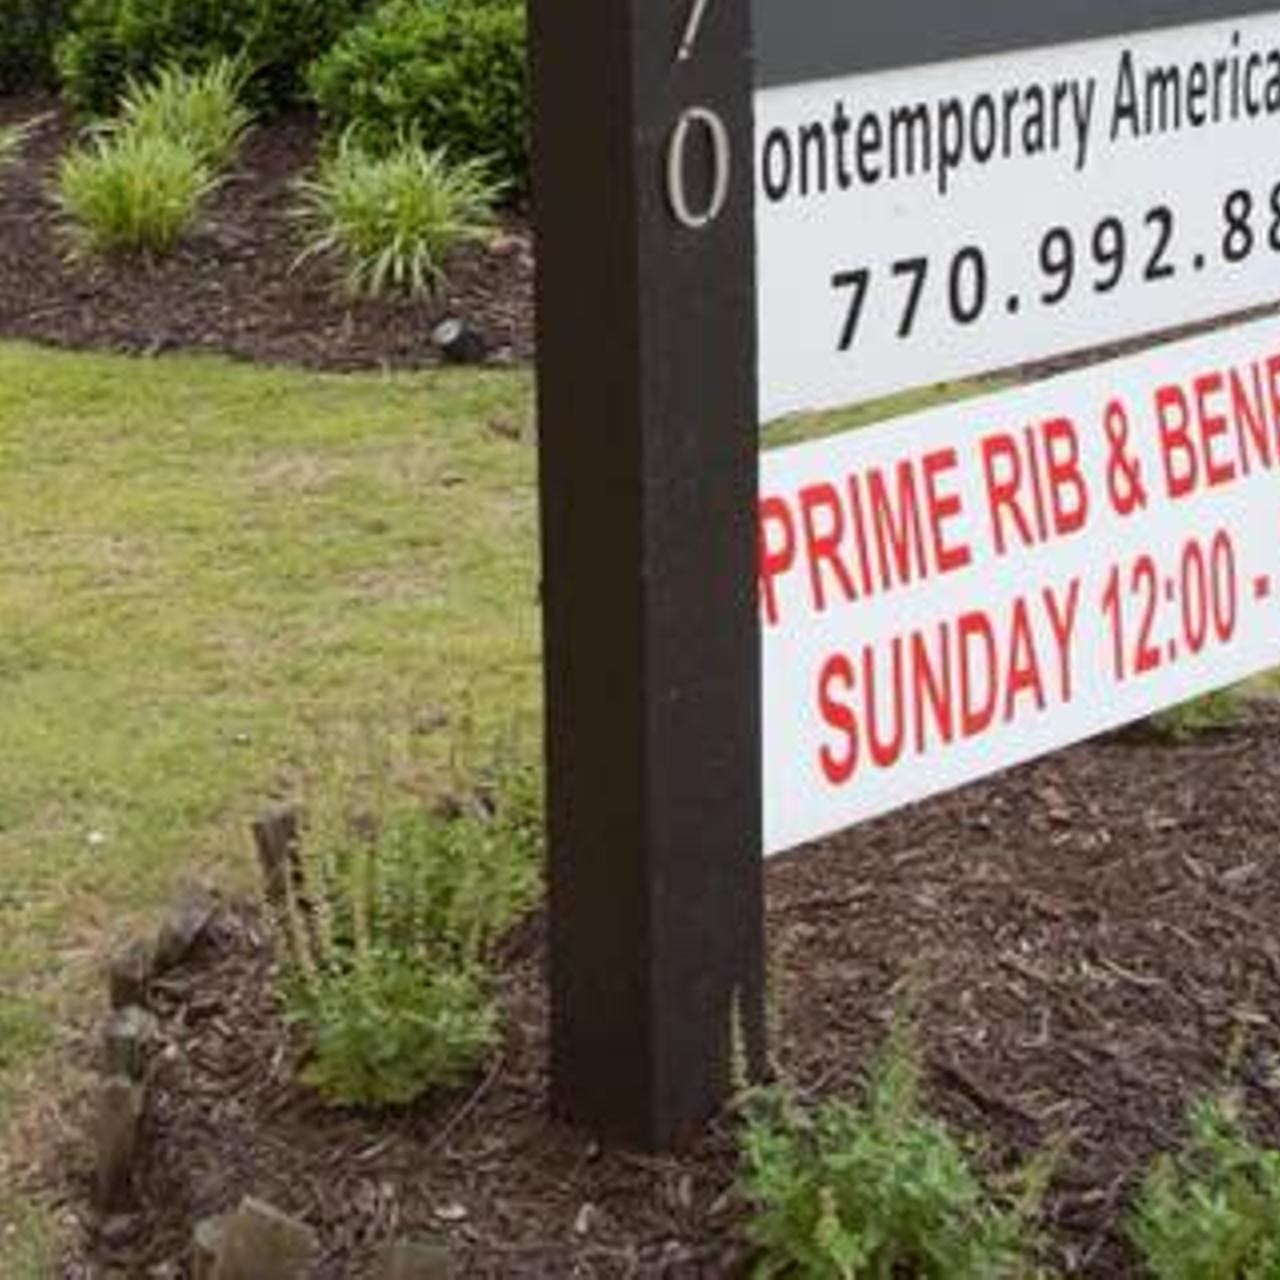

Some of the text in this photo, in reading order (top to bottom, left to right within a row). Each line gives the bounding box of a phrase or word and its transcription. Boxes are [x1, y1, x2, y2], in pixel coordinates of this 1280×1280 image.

[761, 77, 1096, 201] ontemporary
[756, 448, 972, 626] PRIME
[981, 417, 1088, 554] RIB
[1102, 399, 1145, 516] &
[816, 577, 1079, 786] SUNDAY
[1101, 529, 1236, 682] 12:00
[1253, 570, 1269, 599] -
